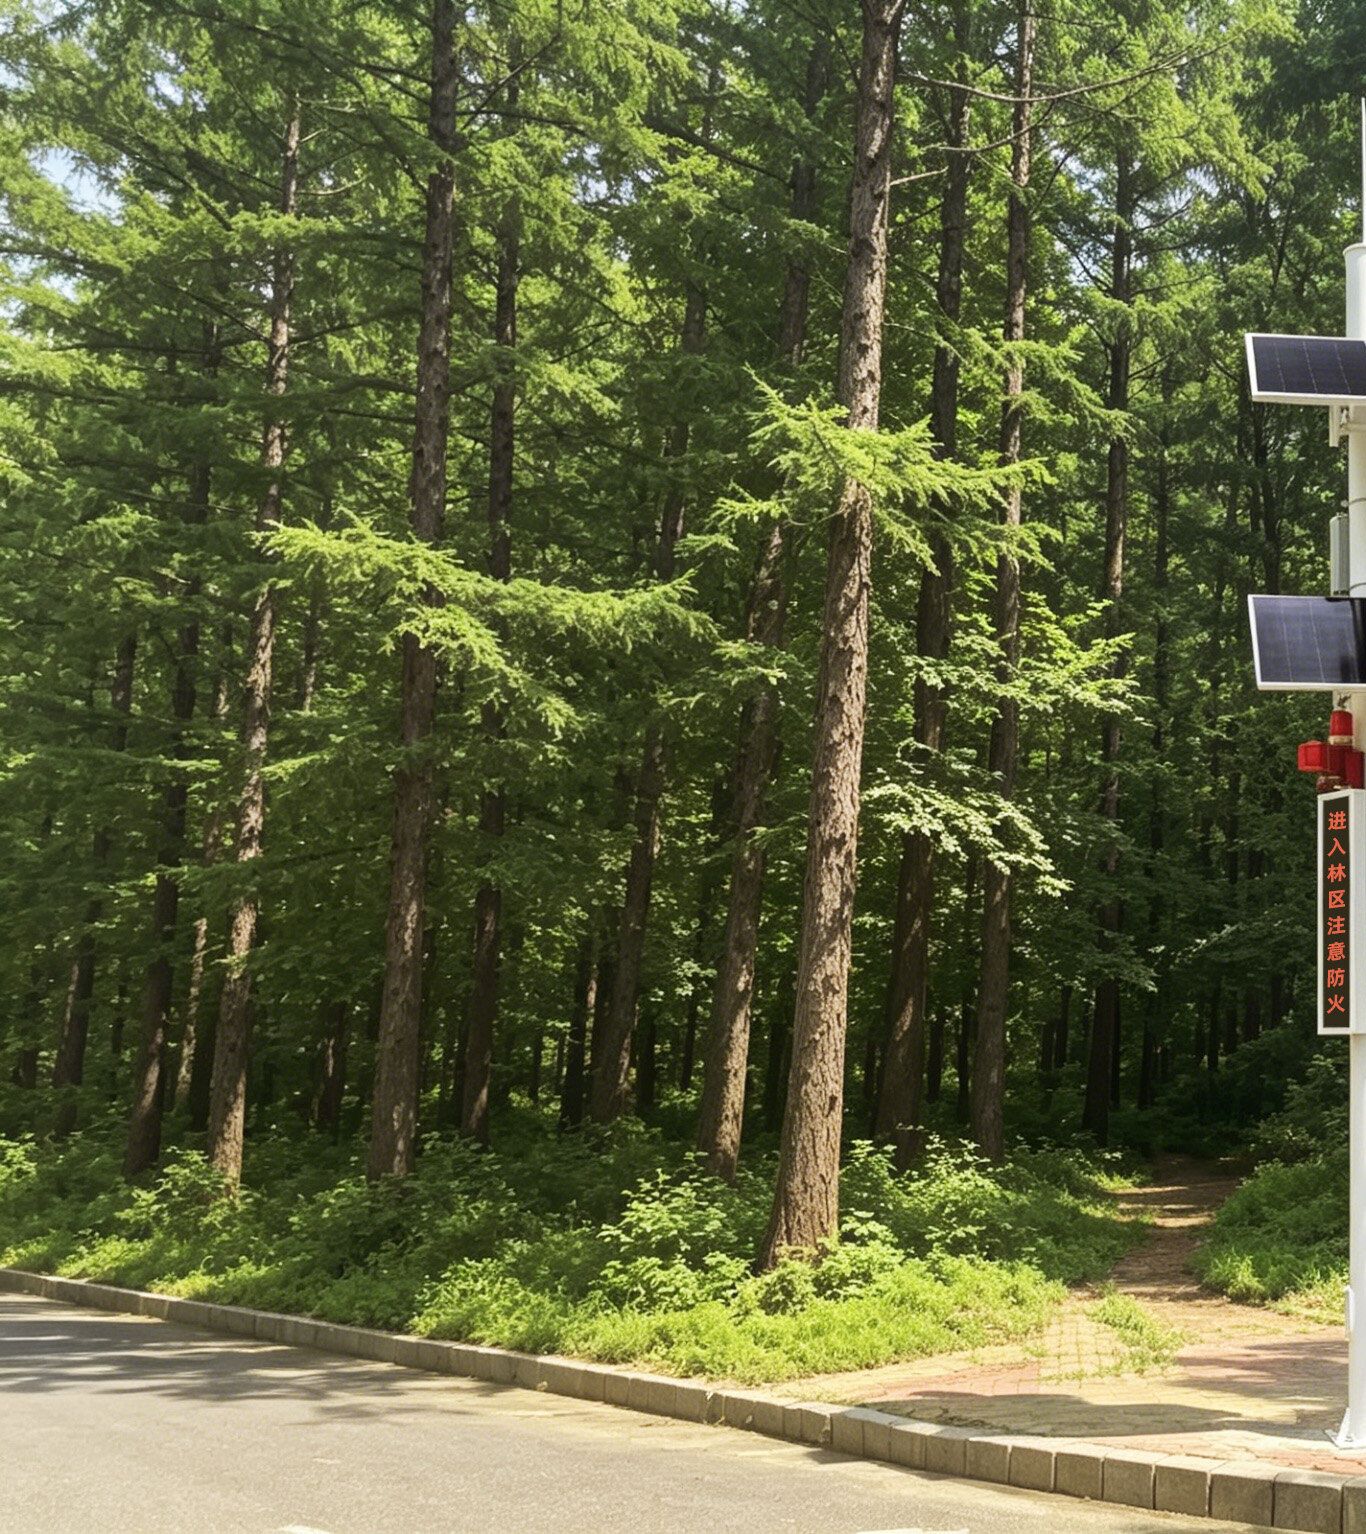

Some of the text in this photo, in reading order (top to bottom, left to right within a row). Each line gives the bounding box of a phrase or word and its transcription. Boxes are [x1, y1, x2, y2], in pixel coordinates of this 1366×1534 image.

[1327, 811, 1347, 1014] 进入林区注意防火
